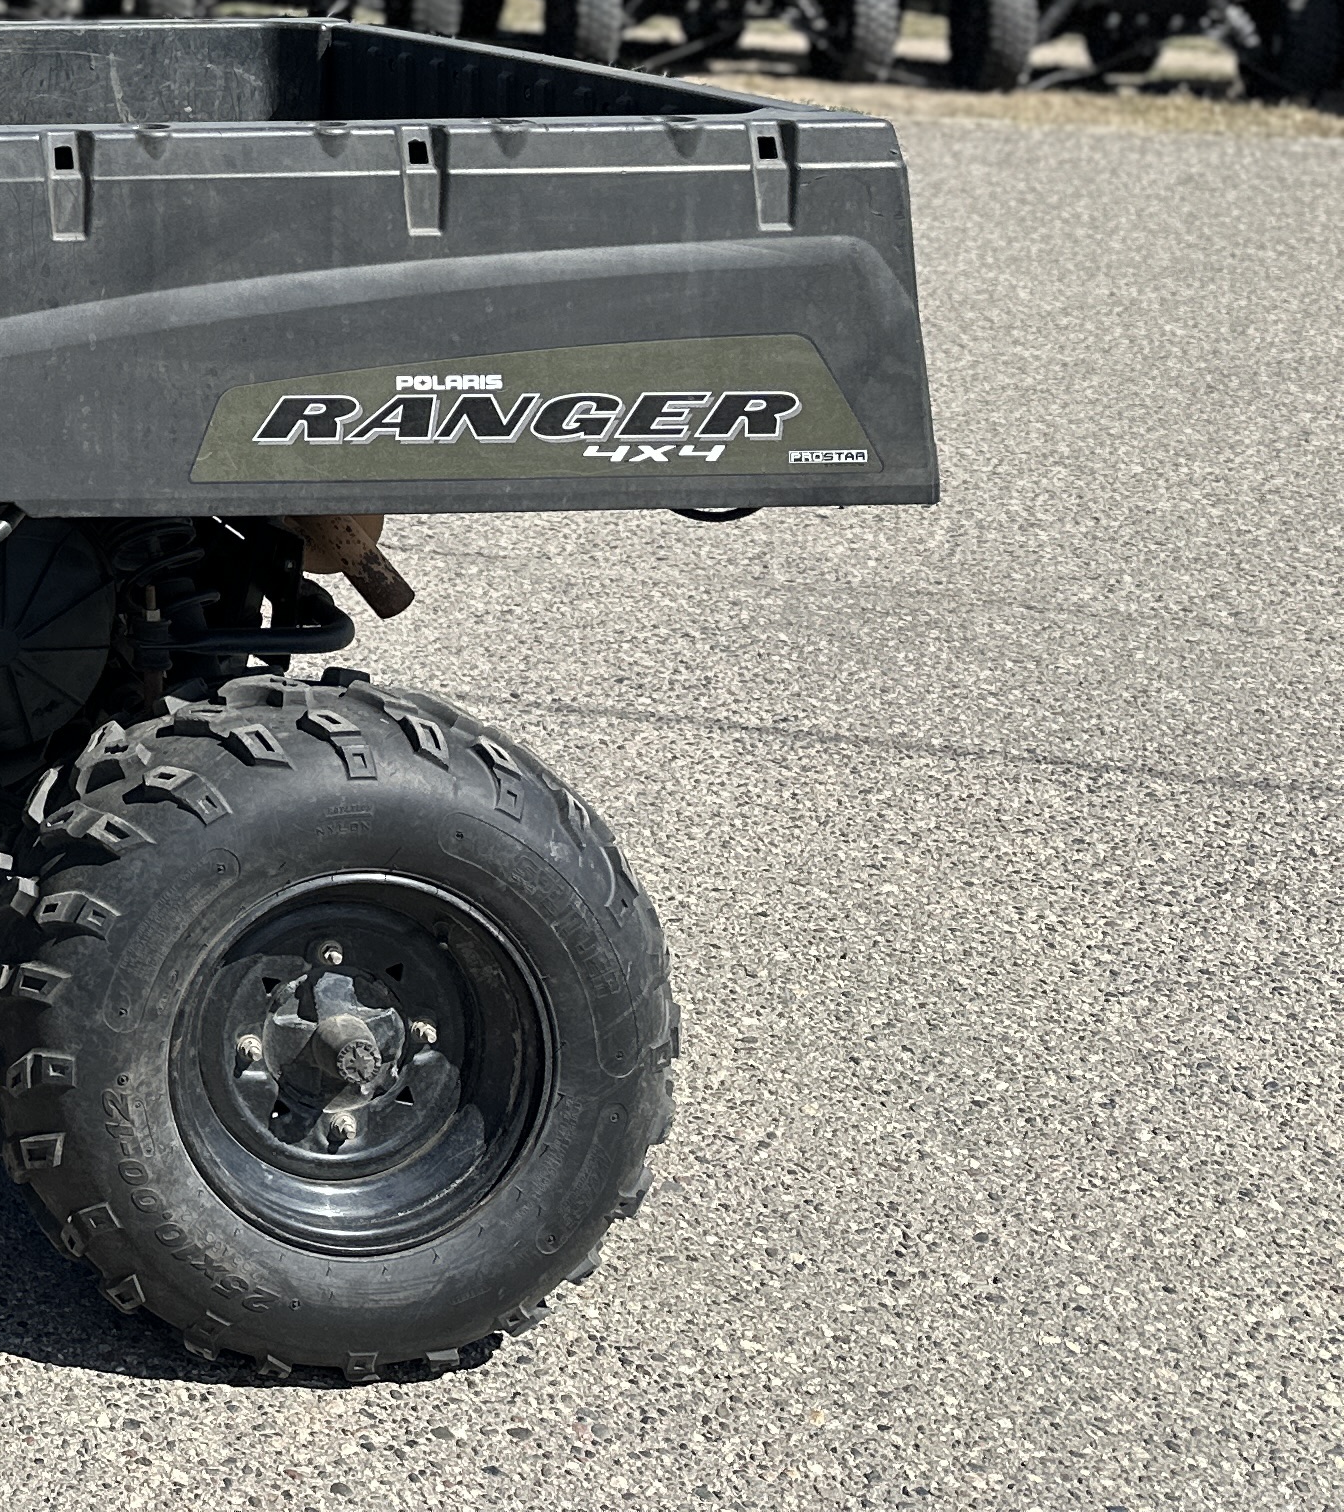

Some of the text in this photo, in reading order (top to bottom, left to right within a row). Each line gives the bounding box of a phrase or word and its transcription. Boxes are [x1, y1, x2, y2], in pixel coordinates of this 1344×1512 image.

[395, 374, 503, 391] POLARIS
[252, 391, 802, 445] RANGER
[789, 450, 867, 463] PROSTAR
